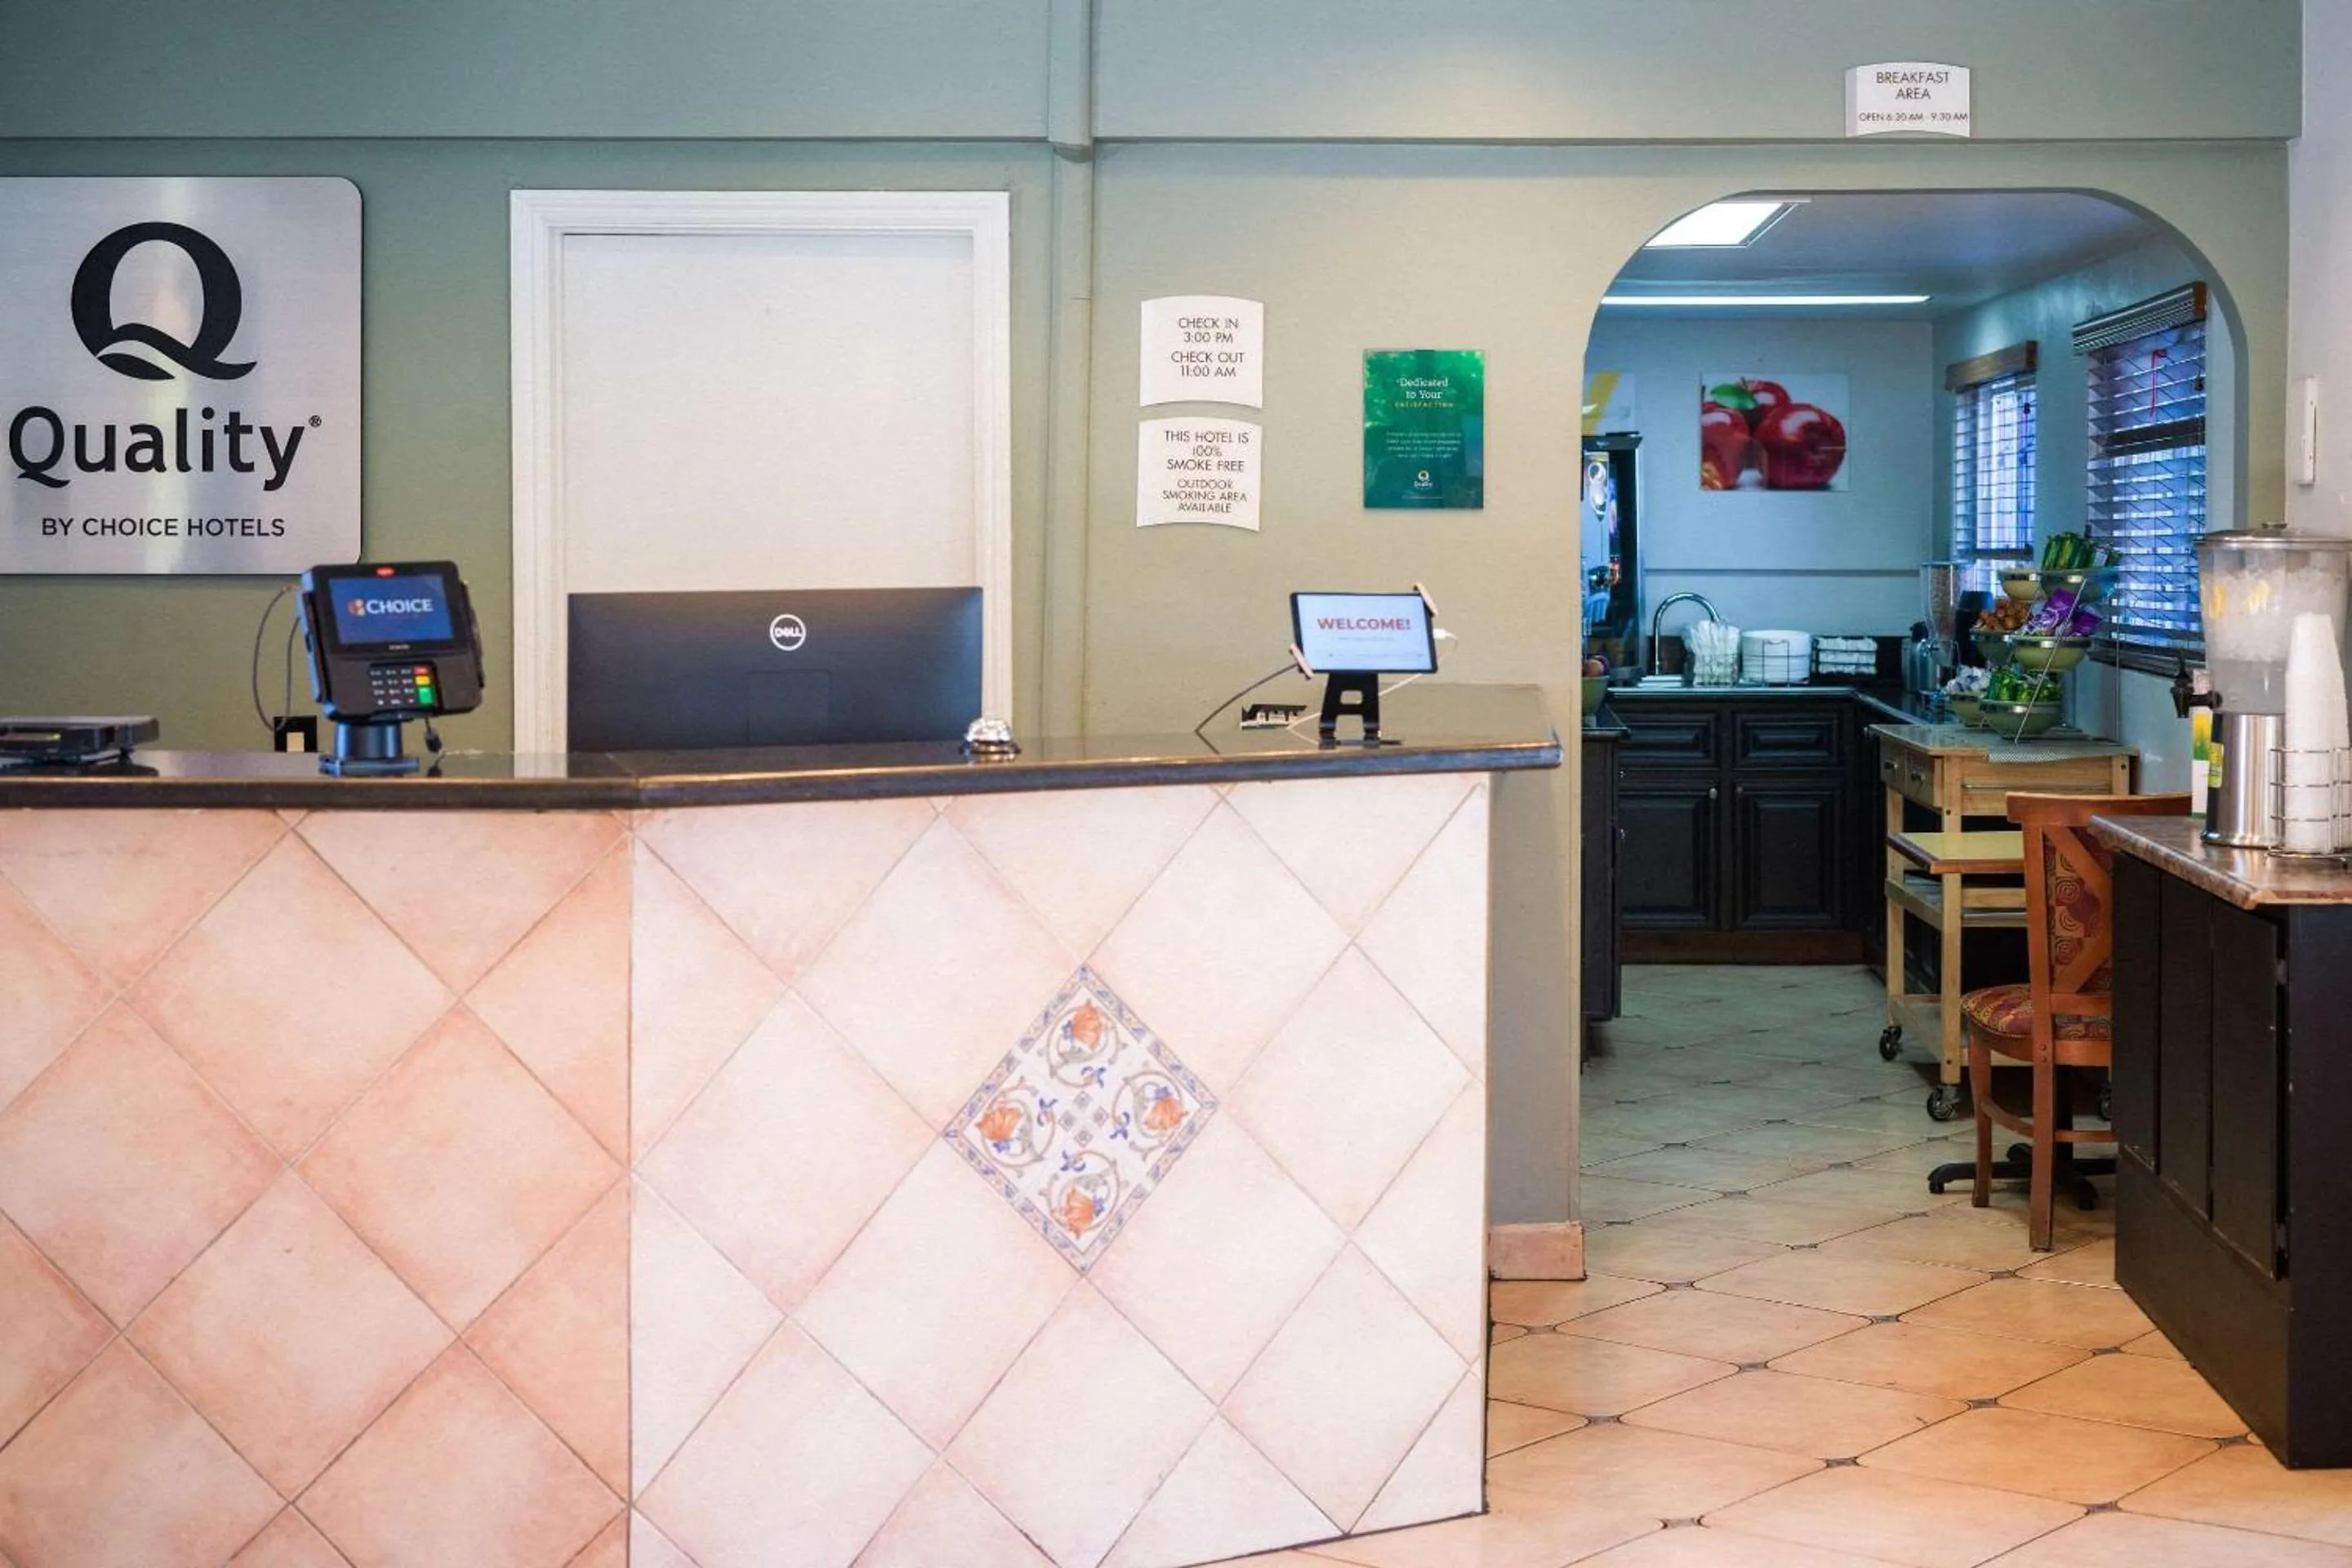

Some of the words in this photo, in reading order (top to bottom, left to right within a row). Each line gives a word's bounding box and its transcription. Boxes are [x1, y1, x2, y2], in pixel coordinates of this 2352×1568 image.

[1876, 71, 1950, 83] BREAKFAST
[1895, 87, 1931, 100] AREA
[1859, 113, 1883, 122] OPEN
[1908, 113, 1923, 122] AM
[1953, 113, 1968, 122] AM
[1178, 317, 1219, 329] CHECK
[1225, 317, 1239, 329] IN
[1183, 332, 1211, 344] 3:00
[1215, 332, 1233, 344] PM
[1170, 351, 1214, 363] CHECK
[1218, 351, 1246, 363] OUT
[1181, 365, 1209, 377] 11:00
[1214, 365, 1236, 377] AM
[1399, 377, 1449, 387] Dedicated
[1405, 390, 1416, 399] to
[1419, 390, 1443, 399] Your
[1164, 430, 1190, 443] THIS
[1195, 430, 1233, 443] HOTEL
[1237, 431, 1249, 443] IS
[1192, 445, 1223, 457] 100%
[1166, 459, 1212, 471] SMOKE
[1218, 460, 1245, 472] FREE
[1177, 479, 1233, 489] OUTDOOR
[1162, 490, 1215, 501] SMOKING
[1219, 492, 1247, 502] AREA
[1177, 502, 1232, 513] AVAILABLE
[42, 518, 74, 537] BY
[82, 518, 179, 537] CHOICE
[188, 518, 285, 537] HOTELS
[366, 599, 434, 613] CHOICE
[1317, 618, 1411, 630] WELCOME!
[774, 626, 803, 638] DELL
